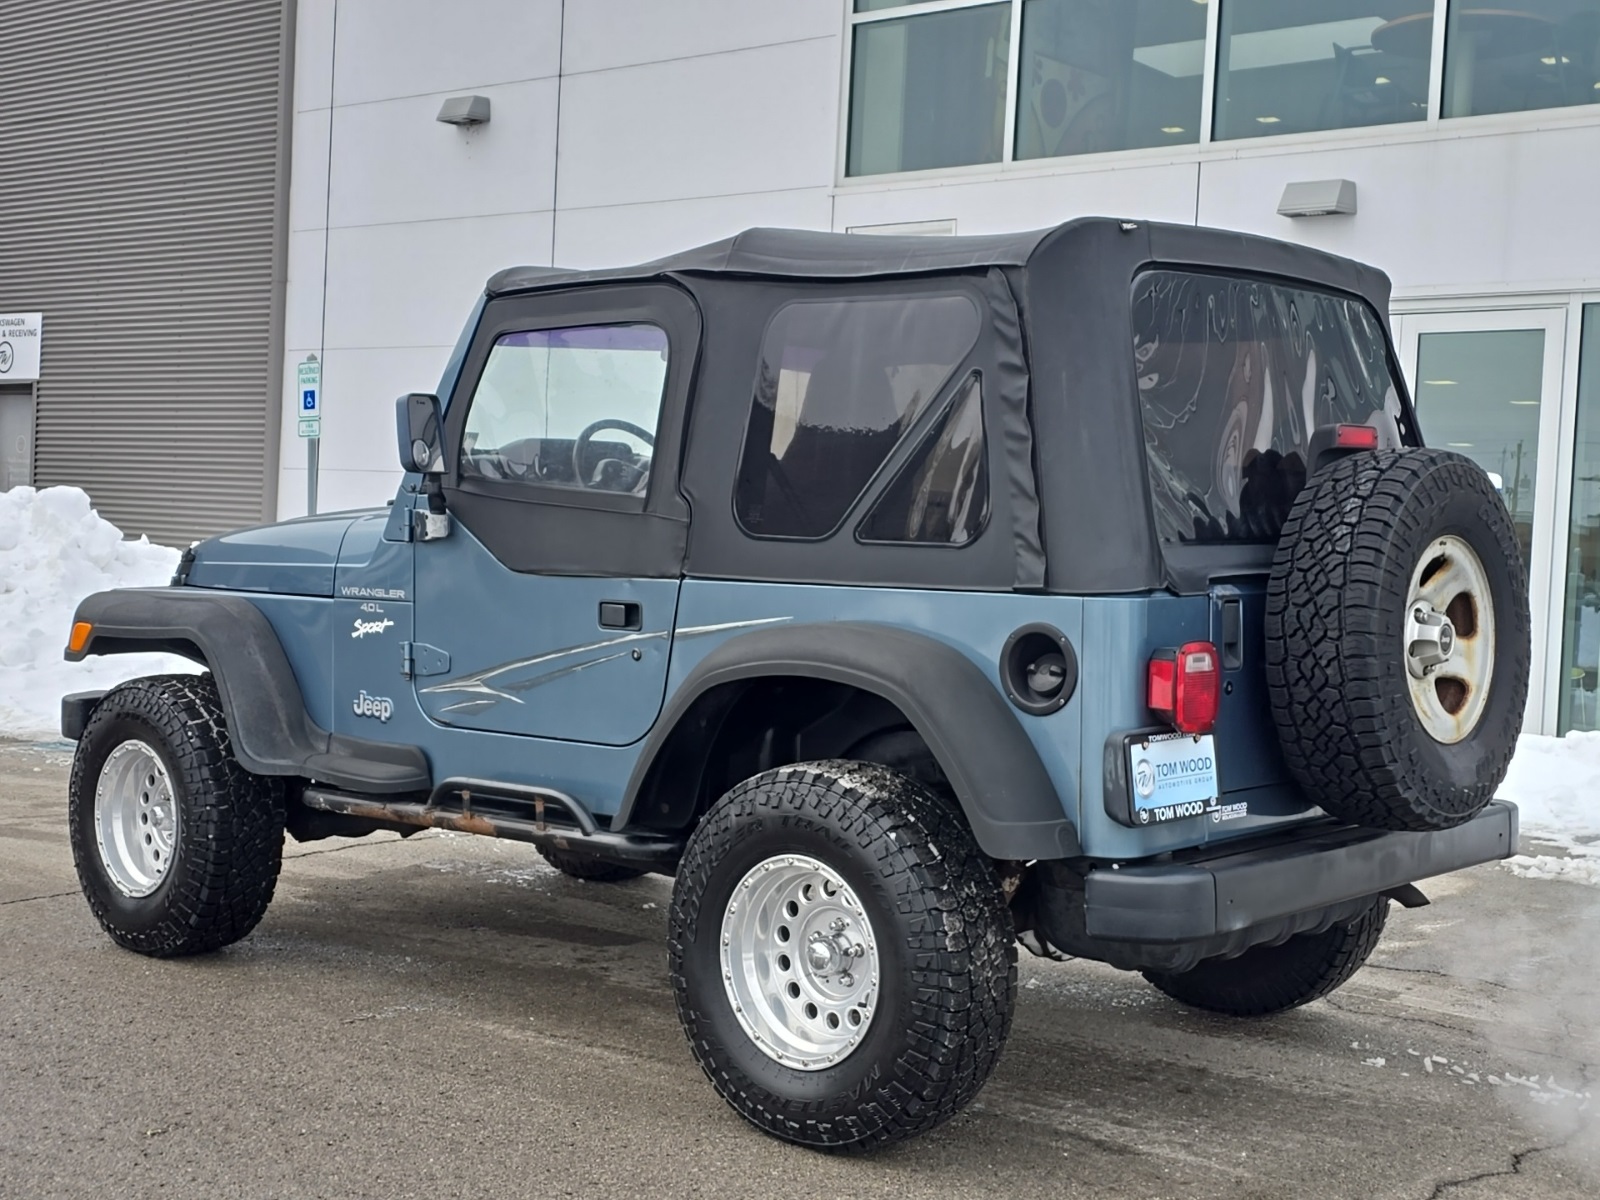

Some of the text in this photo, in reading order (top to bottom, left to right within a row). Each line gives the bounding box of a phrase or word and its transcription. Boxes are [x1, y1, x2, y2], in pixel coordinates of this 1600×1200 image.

[8, 329, 37, 337] RECEIVING
[341, 586, 405, 599] WRANGLER
[353, 690, 394, 723] Jeep
[1156, 757, 1212, 777] TOM WOOD
[1158, 776, 1213, 790] AUTOMOTIVE GROUP
[1154, 806, 1174, 822] TOM
[1176, 802, 1204, 818] WOOD
